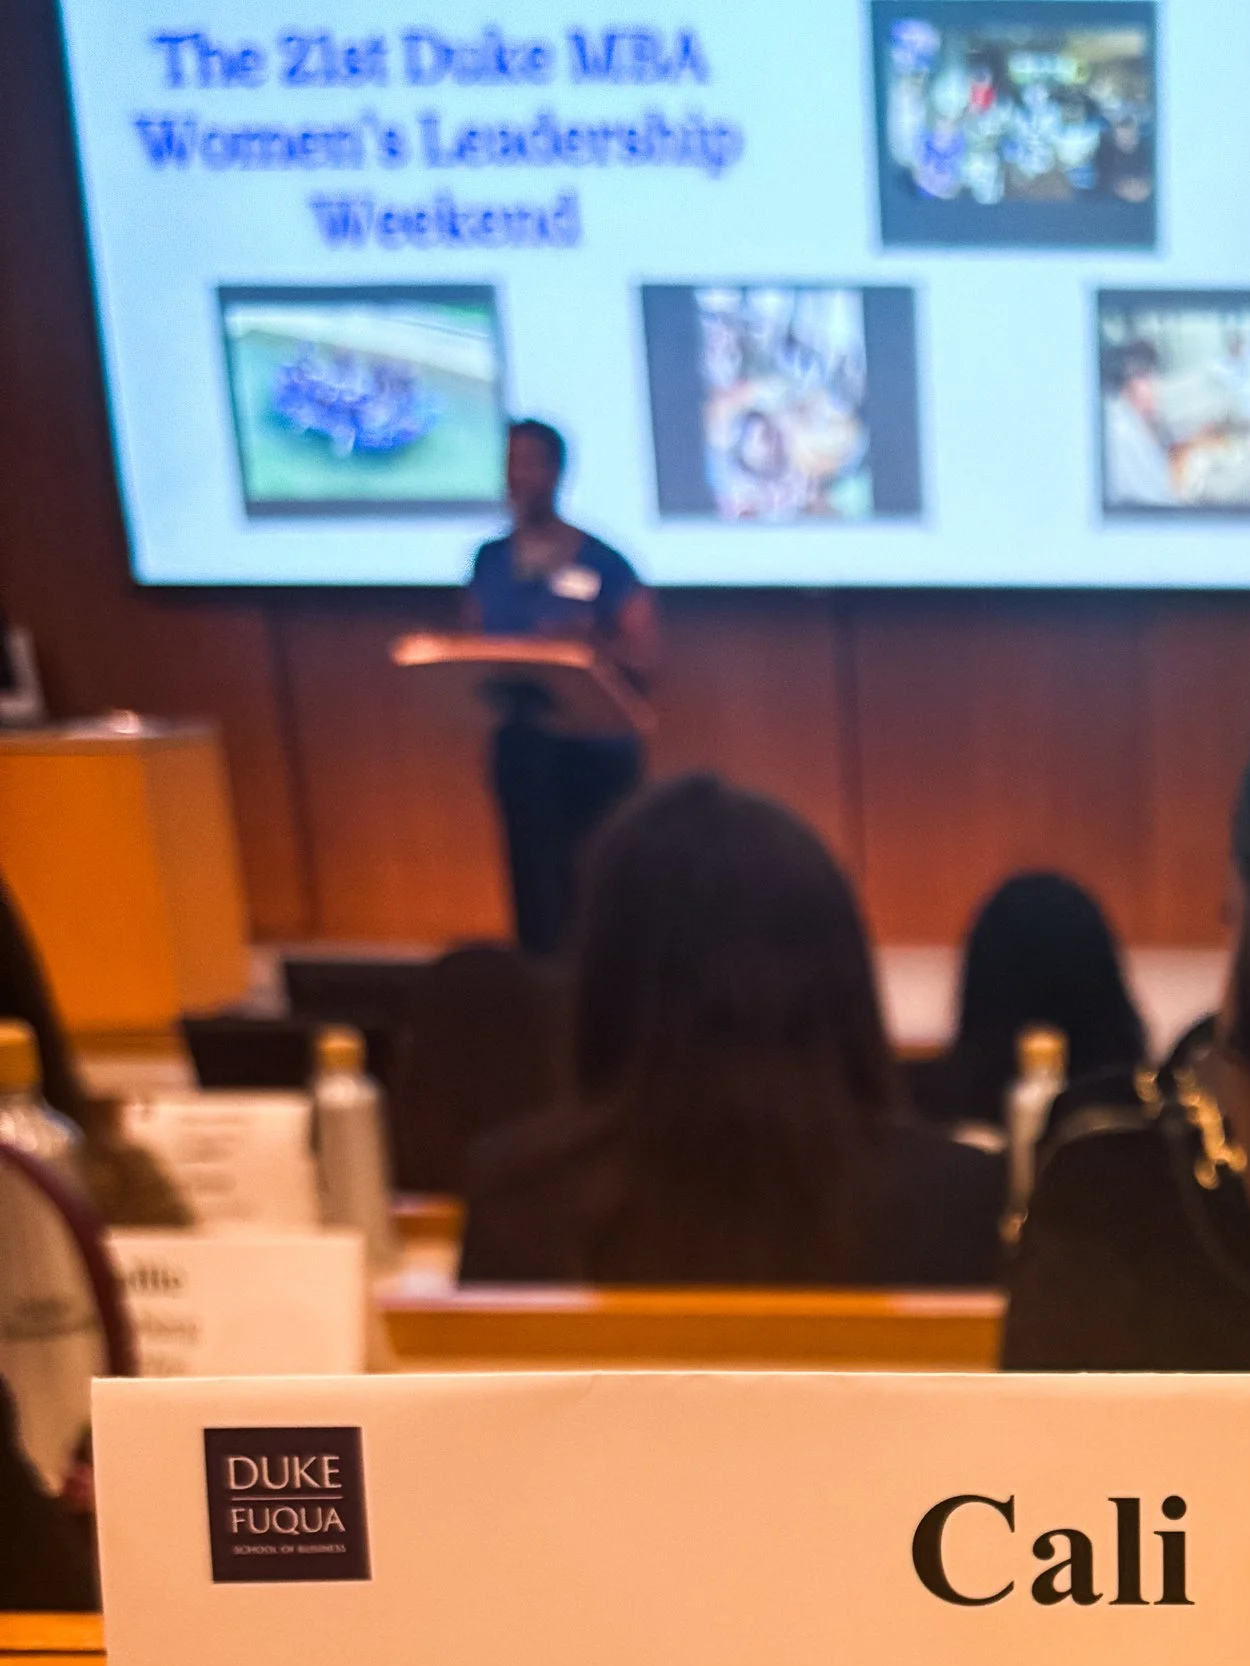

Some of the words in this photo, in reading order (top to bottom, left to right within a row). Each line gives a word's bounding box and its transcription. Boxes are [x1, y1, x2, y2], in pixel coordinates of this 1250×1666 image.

[151, 28, 267, 88] The
[279, 27, 388, 86] 21st
[401, 24, 554, 85] Duke
[567, 26, 711, 85] MBA
[134, 108, 404, 170] Women's
[419, 108, 745, 178] Leadership
[308, 187, 582, 250] Weekend
[228, 1456, 343, 1490] DUKE
[230, 1506, 347, 1535] FUQUA
[911, 1494, 1196, 1607] Cali
